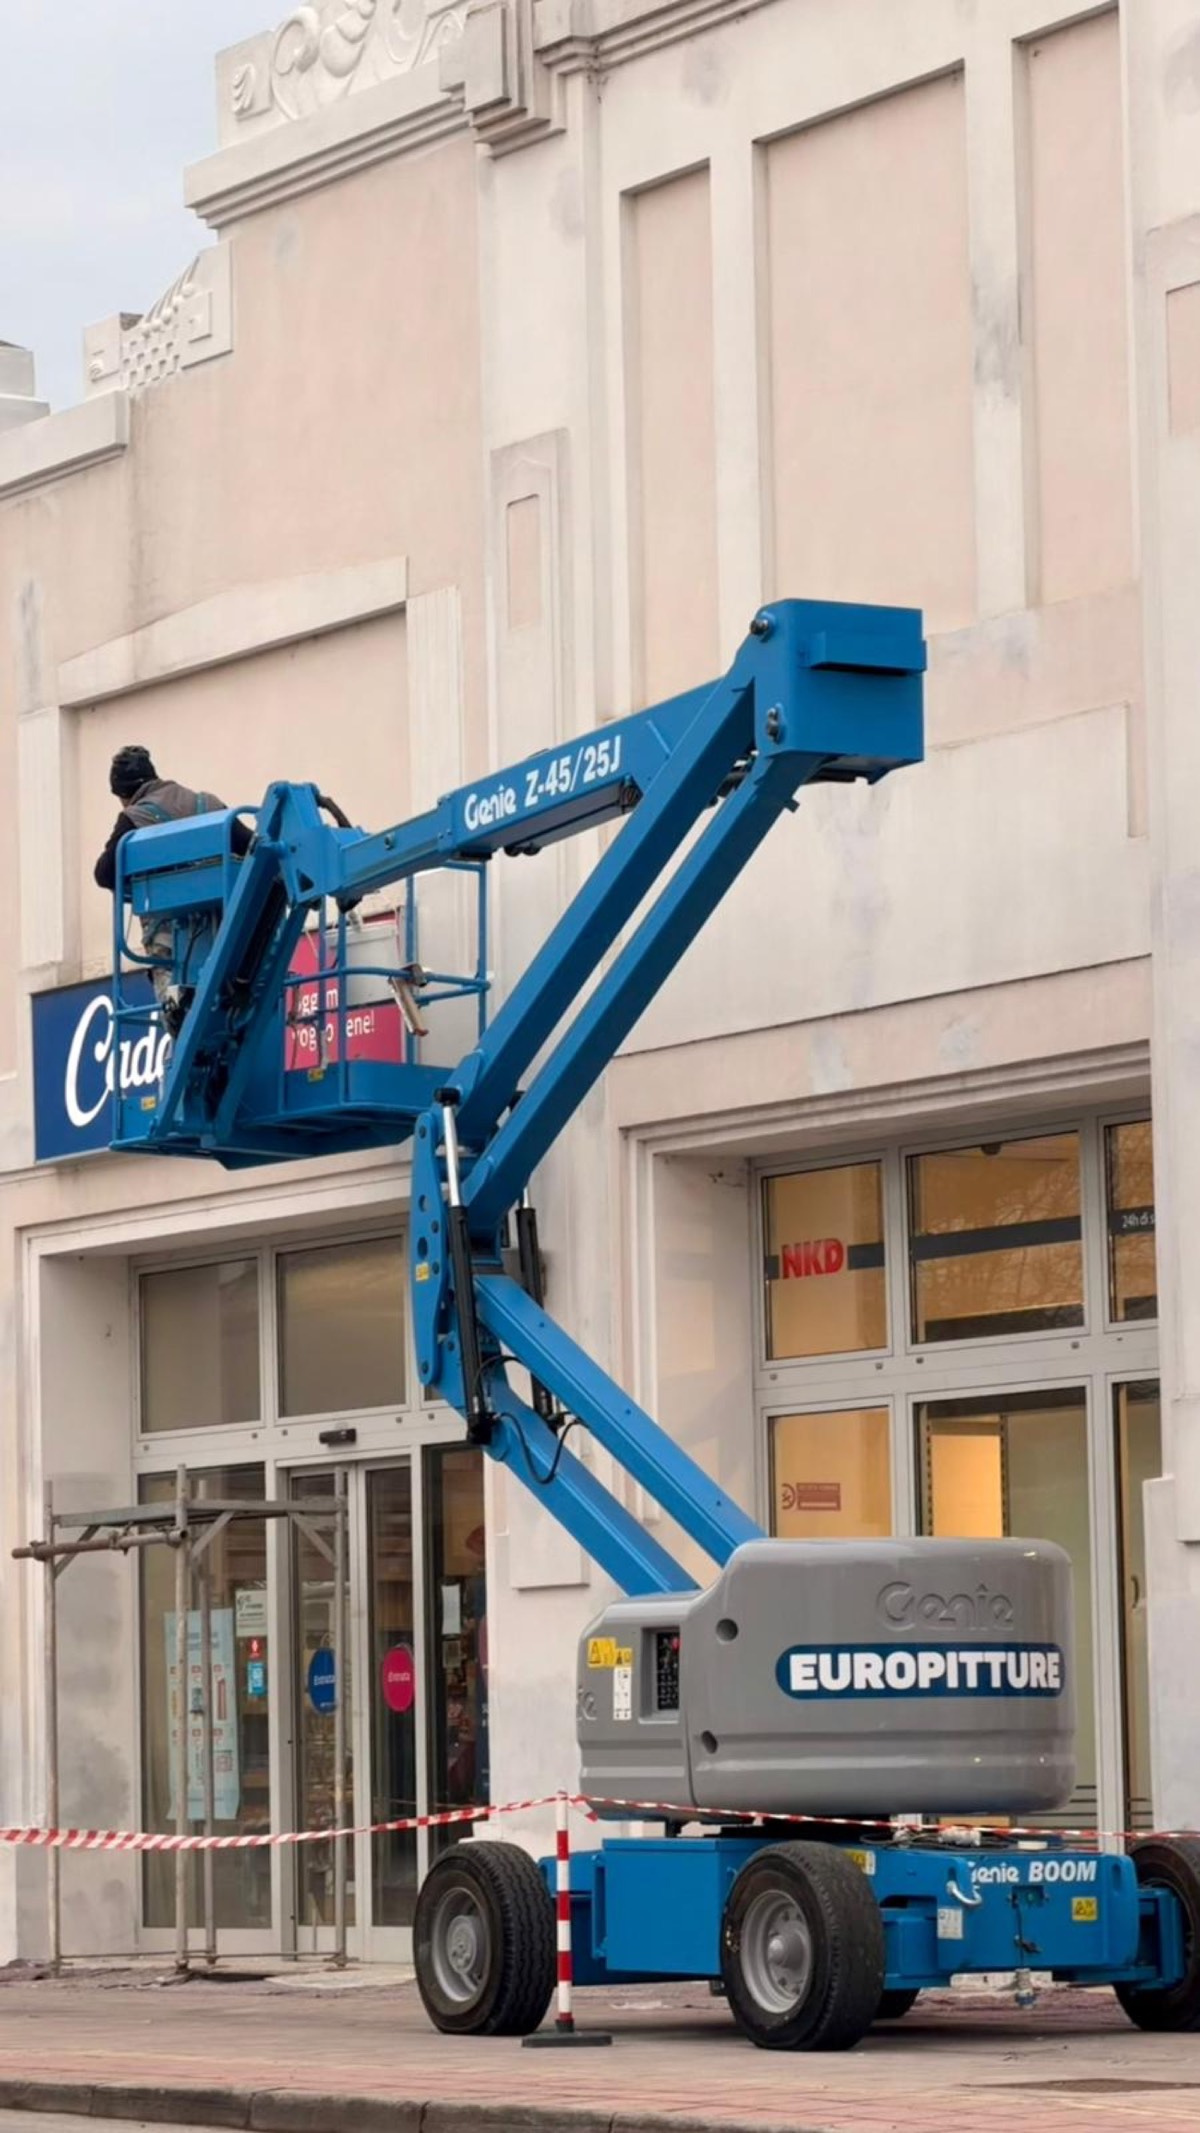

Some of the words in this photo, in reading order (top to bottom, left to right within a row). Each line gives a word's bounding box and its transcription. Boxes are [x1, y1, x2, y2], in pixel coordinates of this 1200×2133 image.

[464, 784, 516, 831] Genie
[525, 735, 621, 807] Z-45/25J
[346, 1009, 375, 1038] ene!
[782, 1238, 844, 1279] NKD
[876, 1581, 1014, 1631] Genie
[789, 1651, 1061, 1691] EUROPITTURE
[1029, 1860, 1097, 1882] BOOM
